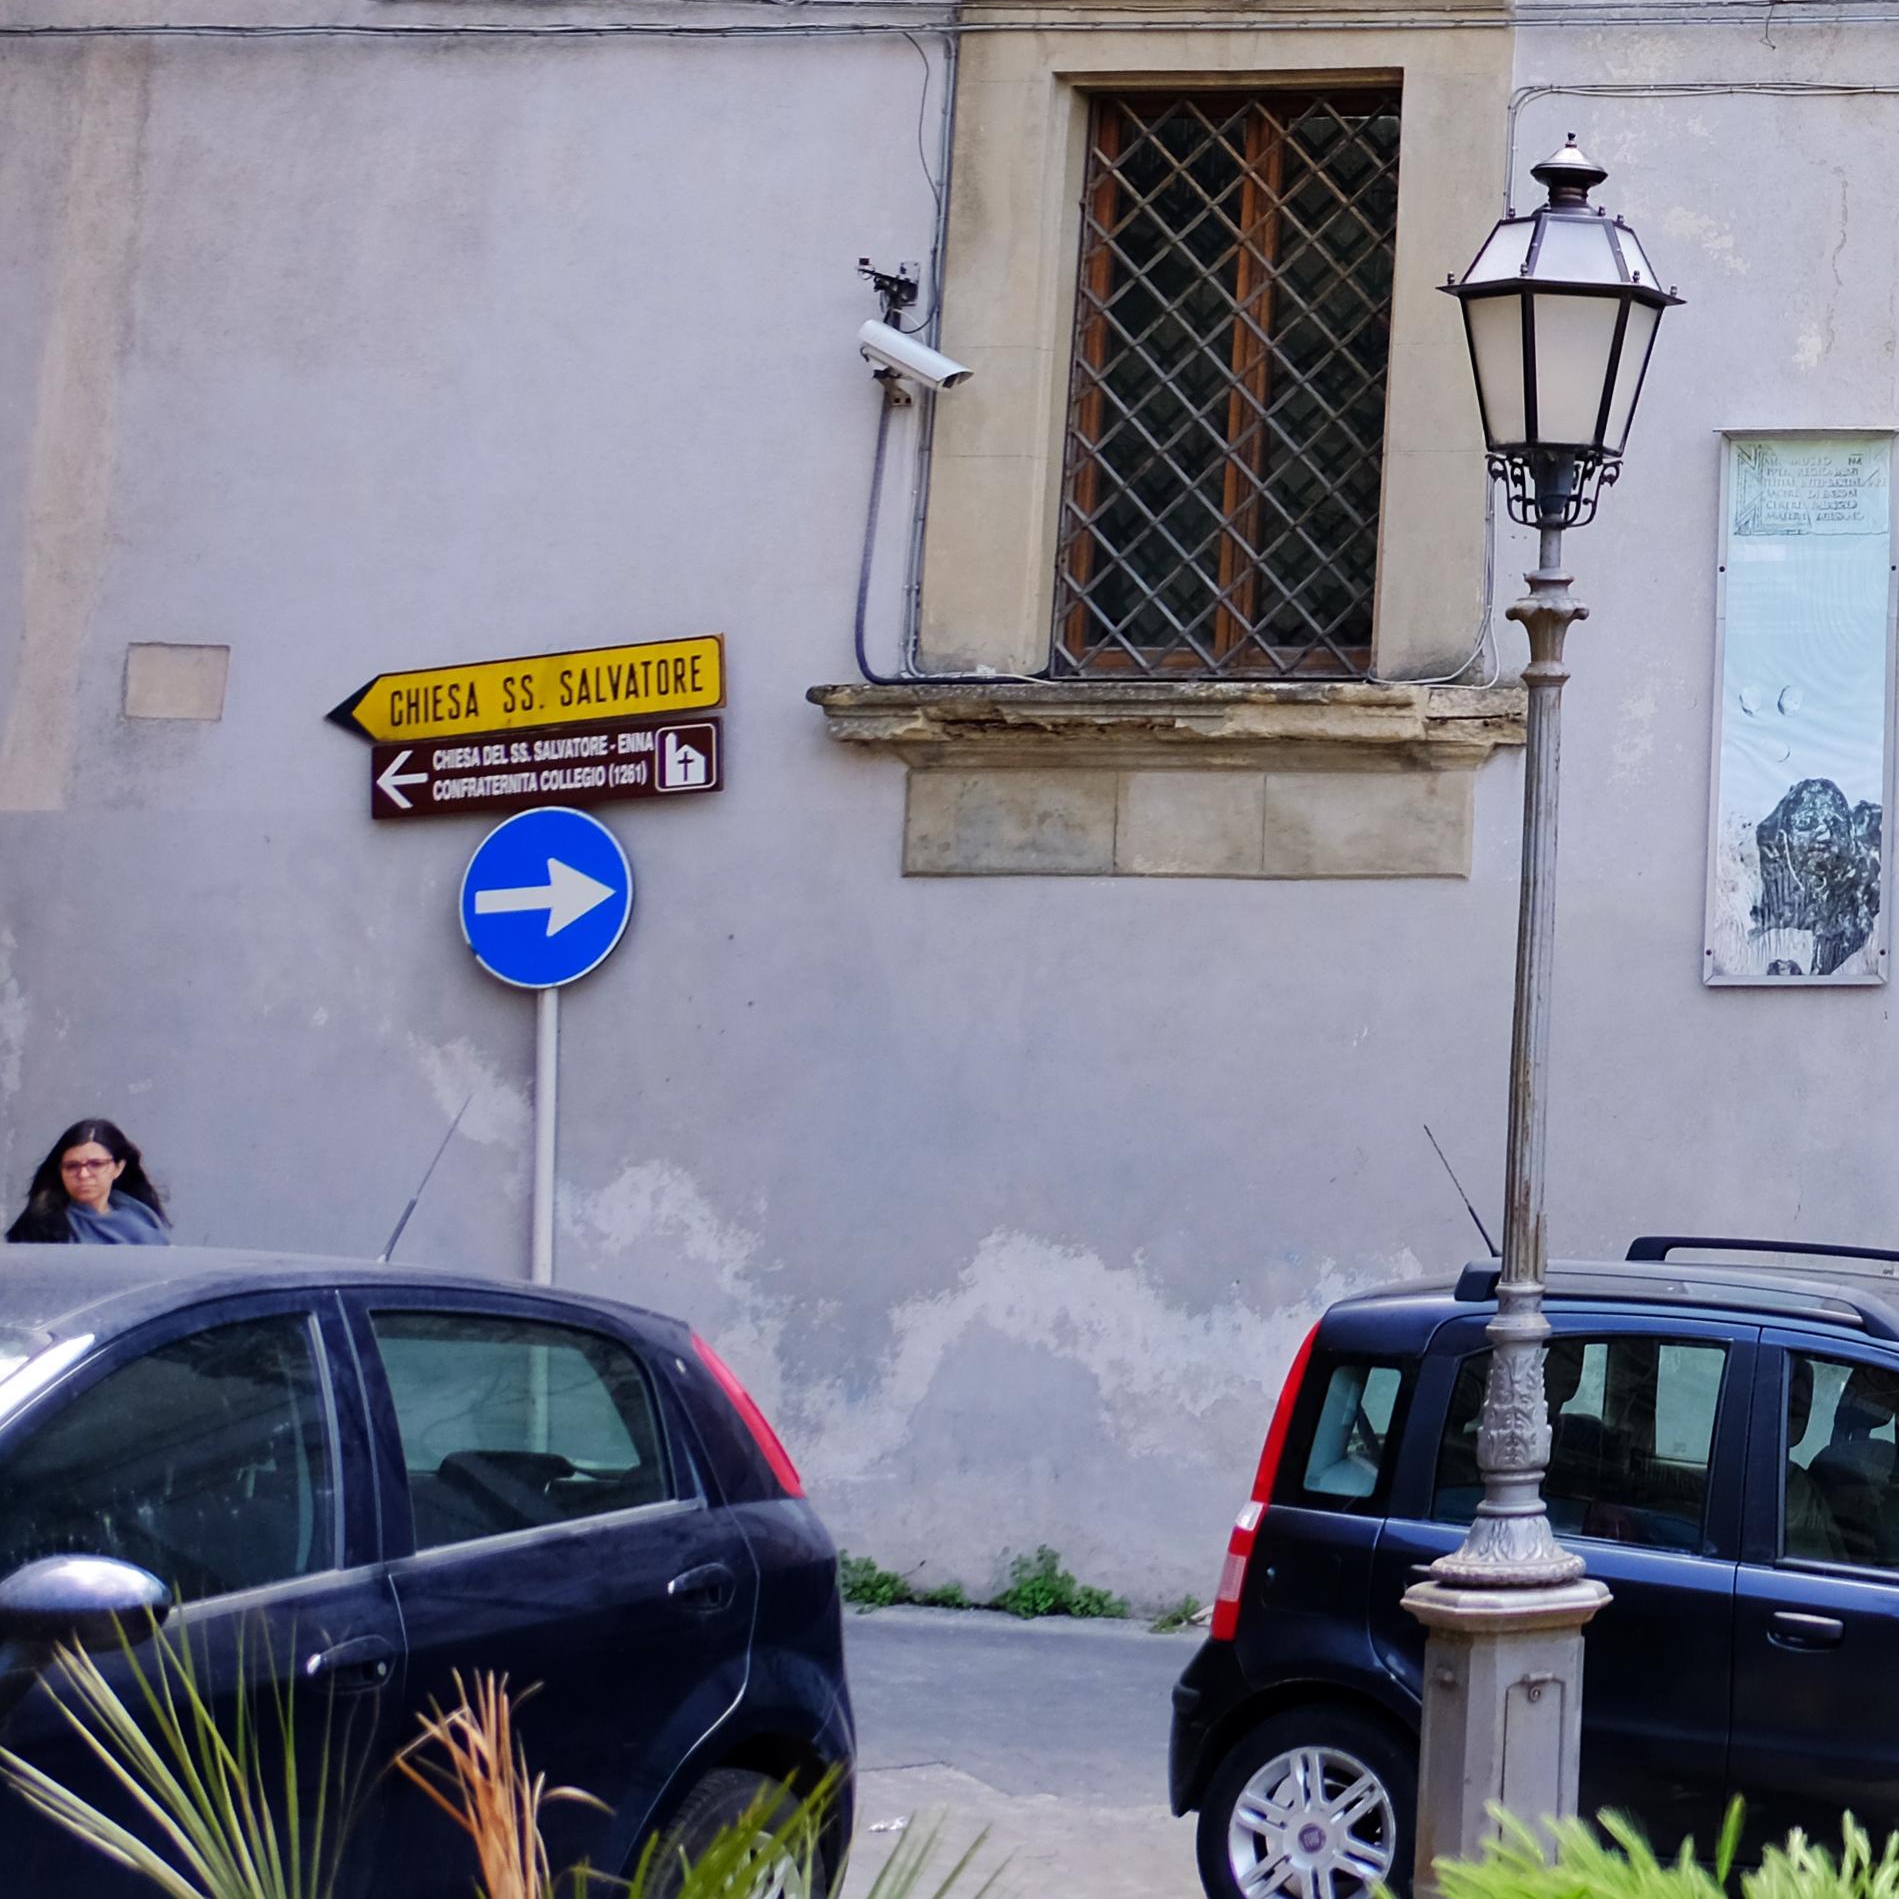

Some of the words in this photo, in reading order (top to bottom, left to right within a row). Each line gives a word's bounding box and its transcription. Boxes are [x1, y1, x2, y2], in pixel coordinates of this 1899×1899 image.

[389, 683, 480, 728] CHIESA
[503, 674, 546, 714] SS.
[559, 653, 704, 709] SALVATORE
[432, 746, 481, 772] CHIESA
[483, 744, 509, 766] DEL
[510, 742, 532, 764] SS.
[534, 735, 608, 761] SALVATORE
[617, 731, 655, 754] ENNA
[432, 772, 539, 802] CONFRATERNITA
[540, 765, 606, 791] COLLEGIO
